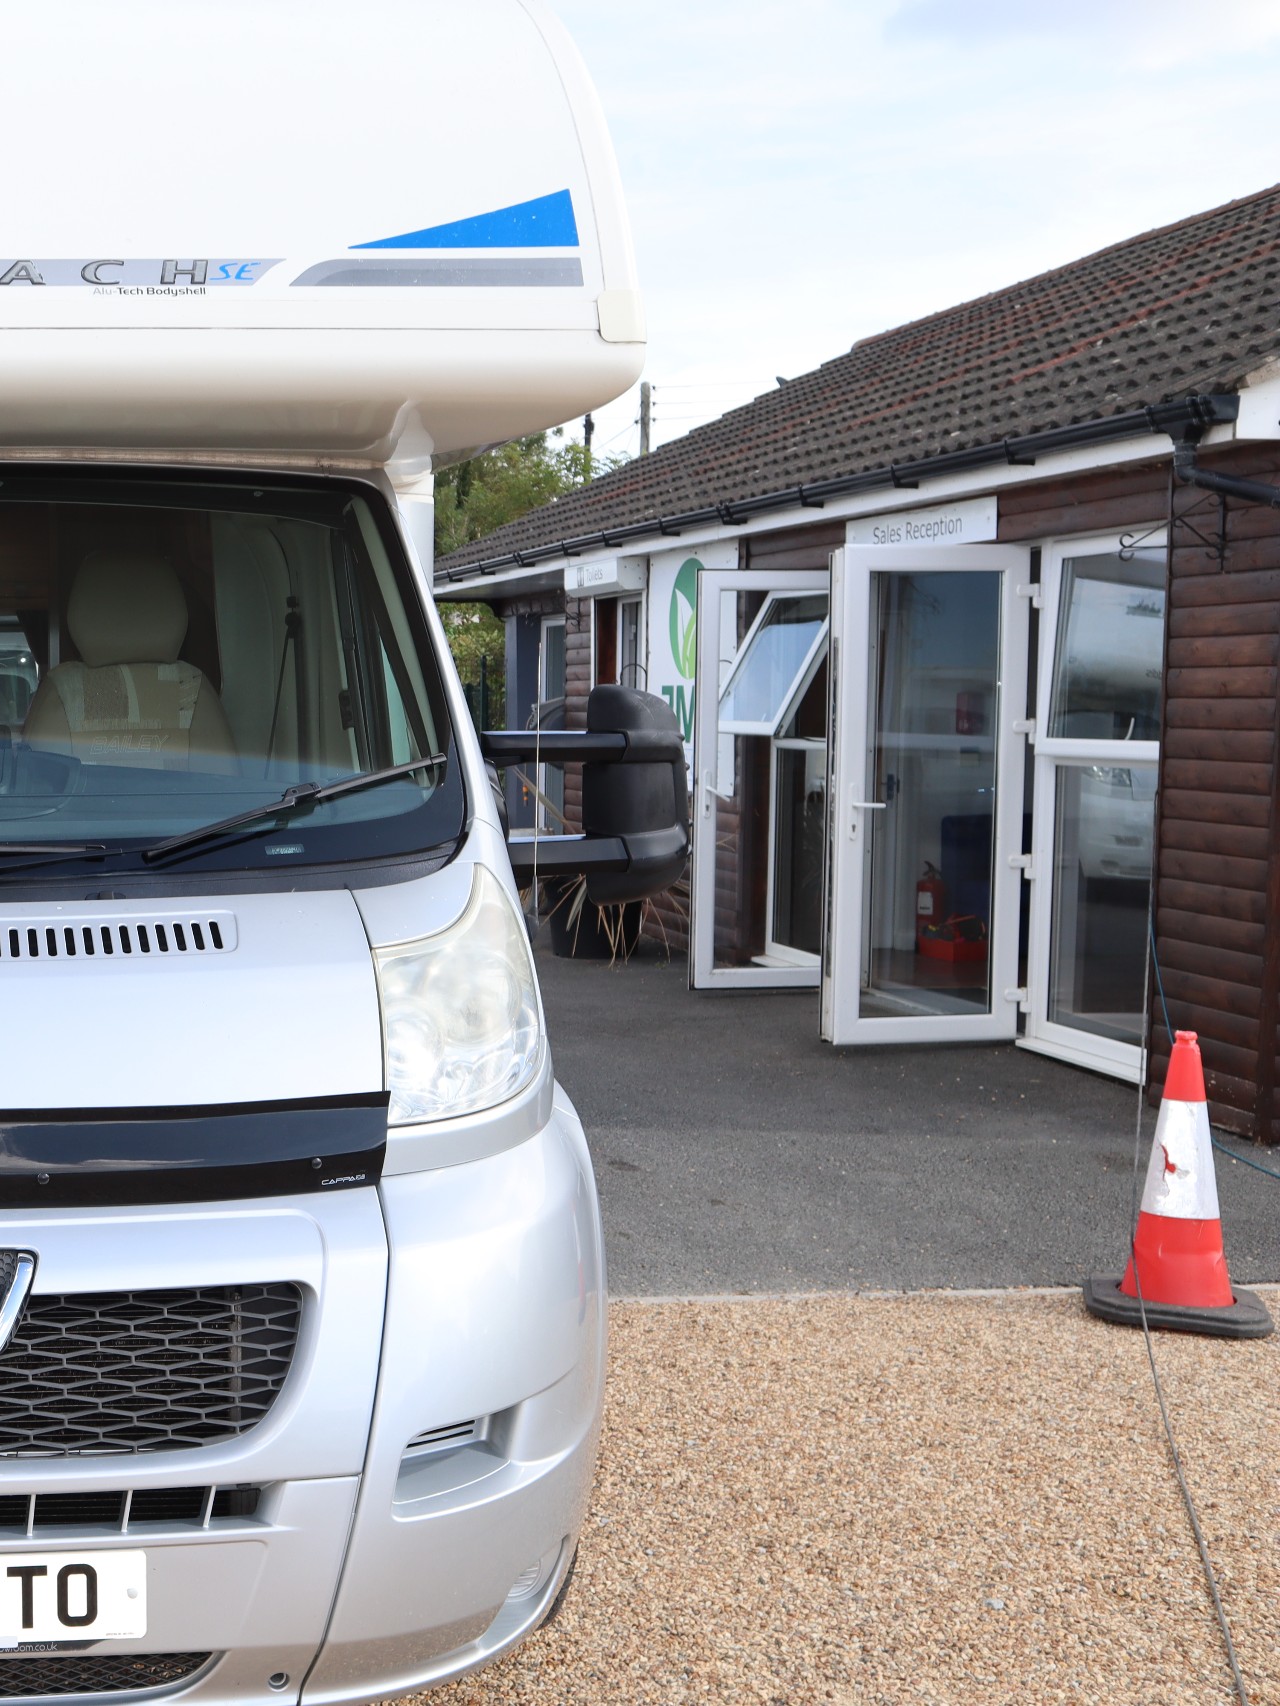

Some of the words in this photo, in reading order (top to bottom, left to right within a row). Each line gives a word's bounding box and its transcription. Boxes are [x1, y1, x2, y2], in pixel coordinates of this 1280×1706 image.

[210, 262, 261, 281] SE
[93, 287, 144, 296] Alu-Tech
[146, 287, 207, 297] Bodyshell
[873, 524, 902, 545] Sales
[905, 515, 963, 541] Reception
[90, 734, 169, 755] BAILEY
